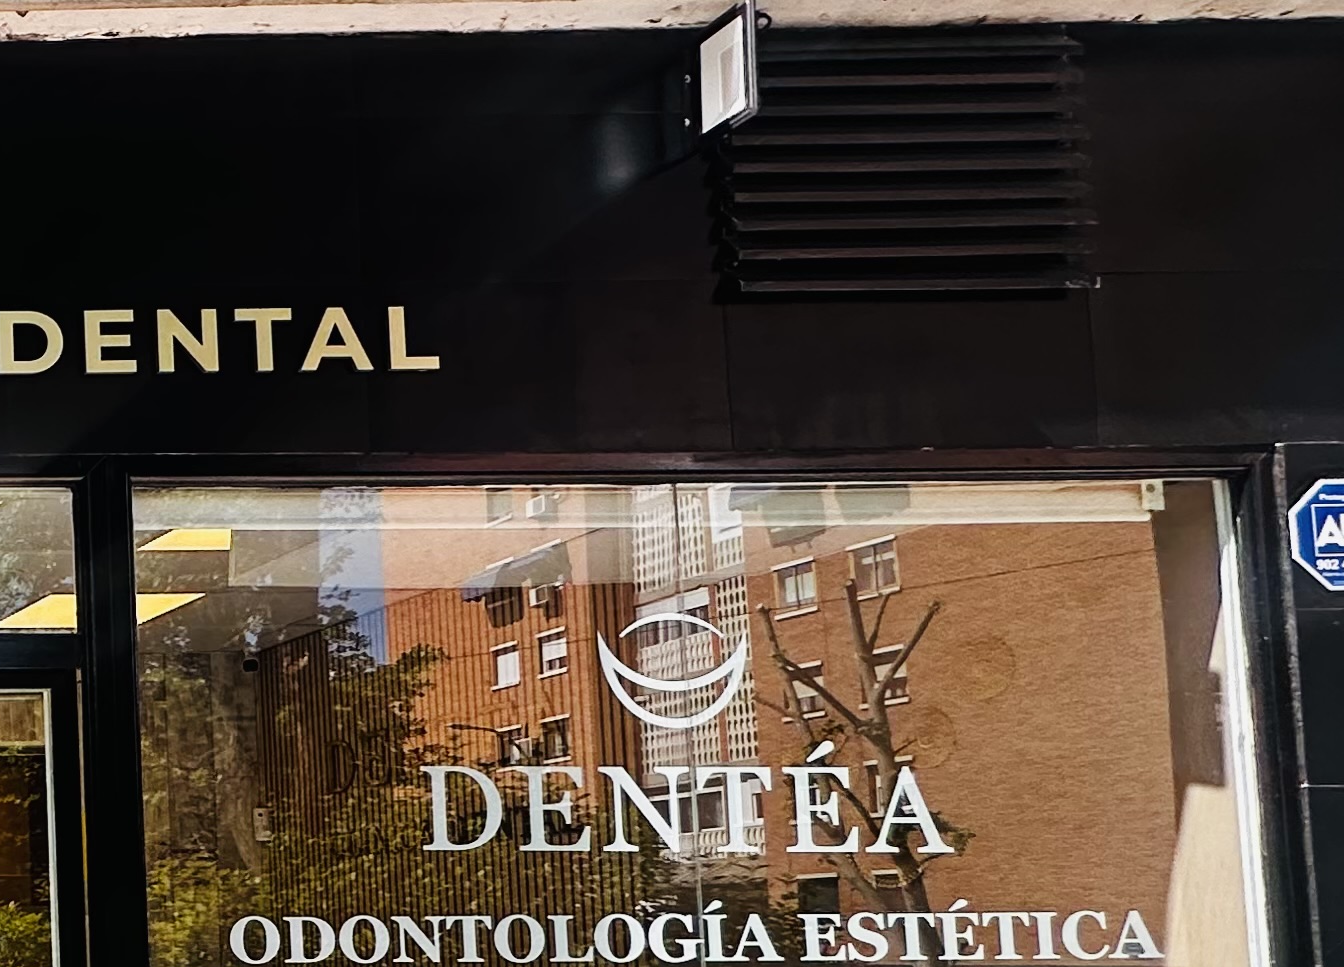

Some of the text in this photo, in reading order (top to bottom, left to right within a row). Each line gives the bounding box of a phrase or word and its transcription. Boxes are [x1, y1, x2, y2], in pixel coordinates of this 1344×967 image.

[421, 740, 954, 855] DENTÉA
[229, 899, 1165, 965] ODONTOLOGÍA ESTÉTICA
